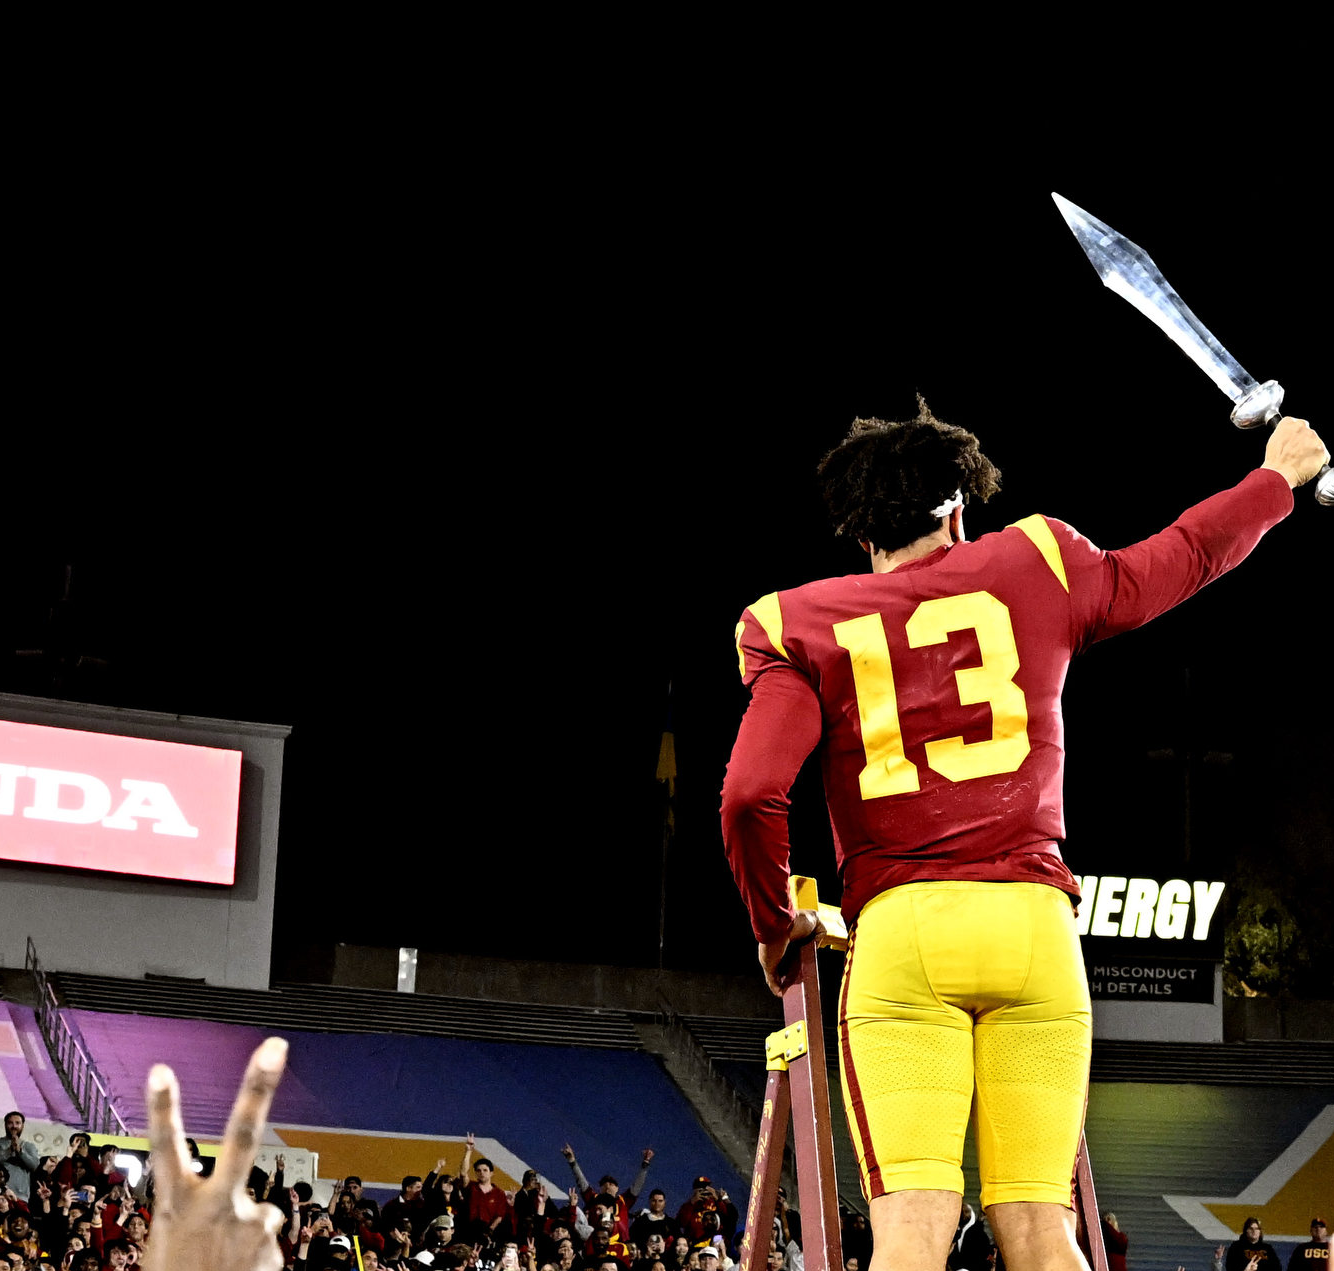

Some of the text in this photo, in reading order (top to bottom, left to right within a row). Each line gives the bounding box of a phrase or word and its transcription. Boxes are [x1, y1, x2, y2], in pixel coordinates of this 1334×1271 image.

[833, 590, 1031, 800] 13
[1093, 966, 1197, 980] MISCONDUCT
[1107, 983, 1172, 995] DETAILS
[1305, 1248, 1329, 1259] USC
